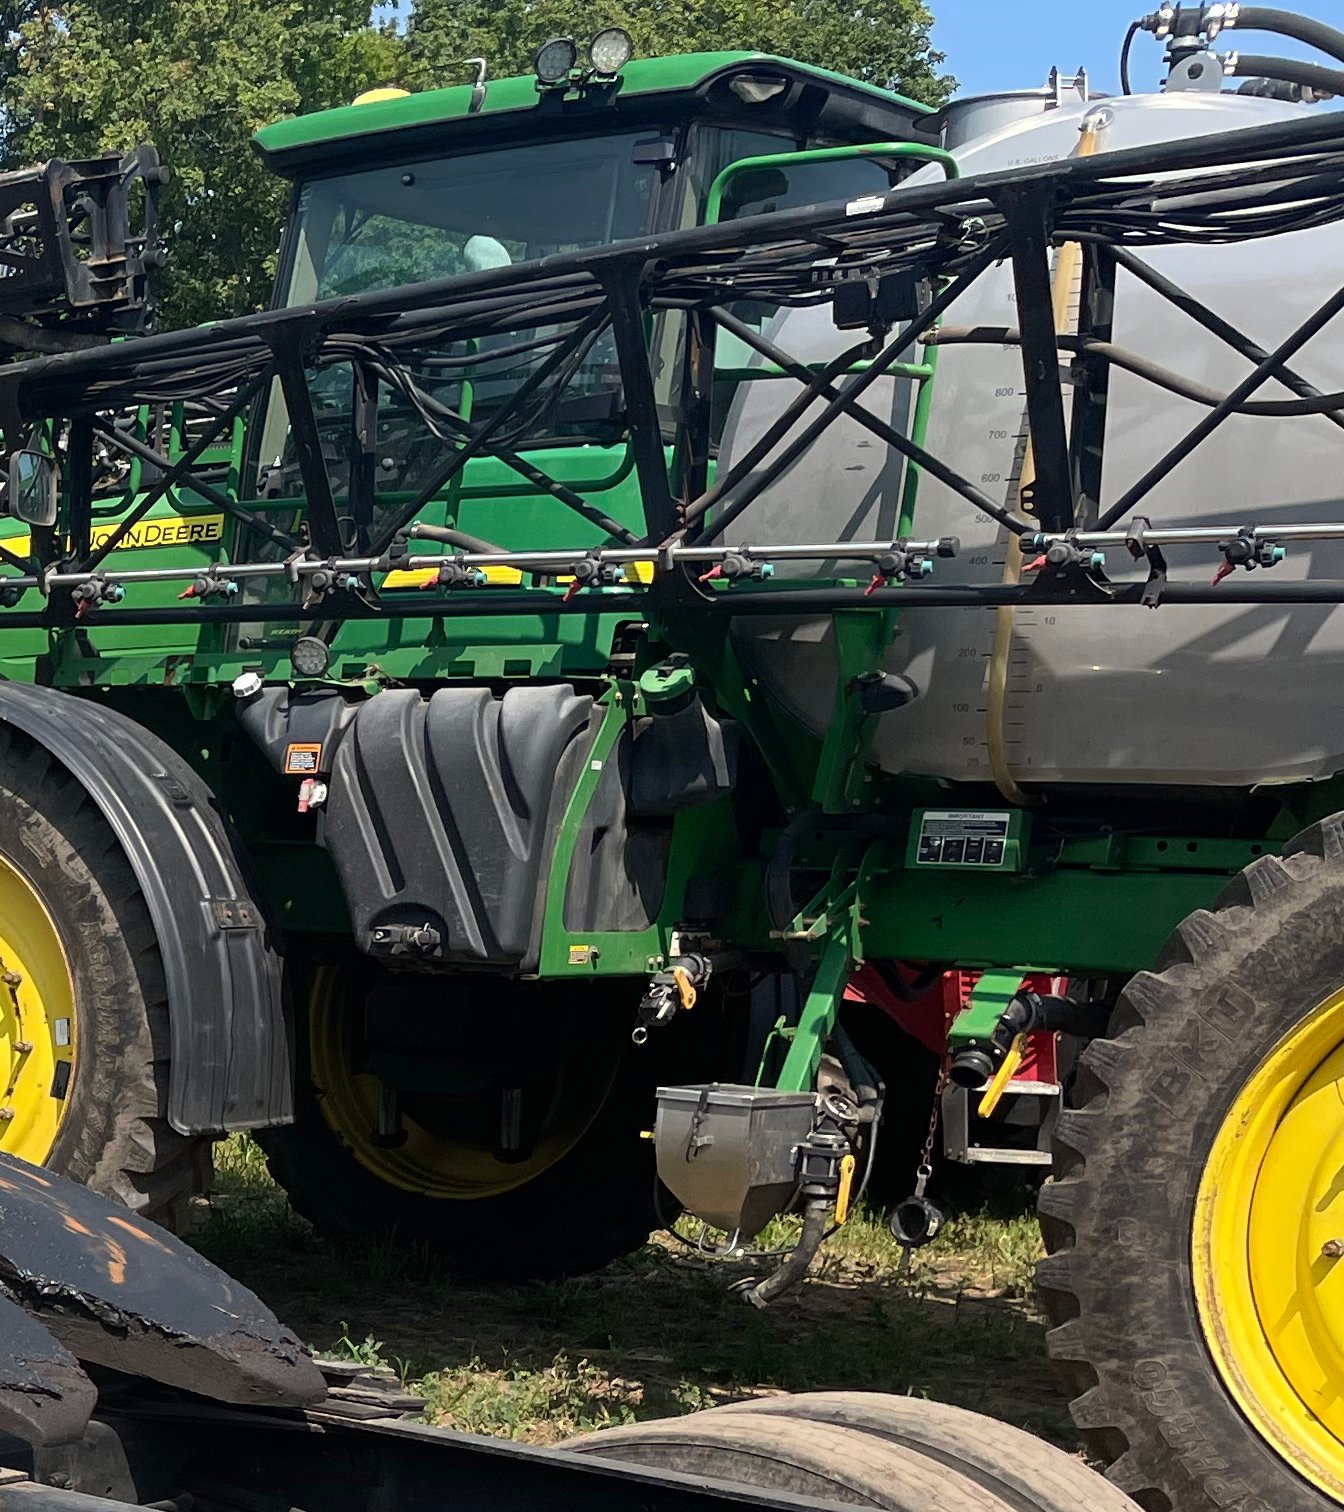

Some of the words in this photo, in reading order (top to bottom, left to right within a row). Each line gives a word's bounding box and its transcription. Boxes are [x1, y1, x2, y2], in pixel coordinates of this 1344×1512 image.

[994, 387, 1014, 398] 800
[987, 430, 1007, 440] 700
[980, 473, 1001, 483] 600
[974, 514, 994, 524] 500
[144, 522, 219, 543] DEERE
[968, 556, 988, 566] 400
[1044, 616, 1056, 626] 10
[958, 647, 977, 658] 200
[952, 703, 969, 713] 100
[962, 737, 975, 746] 50
